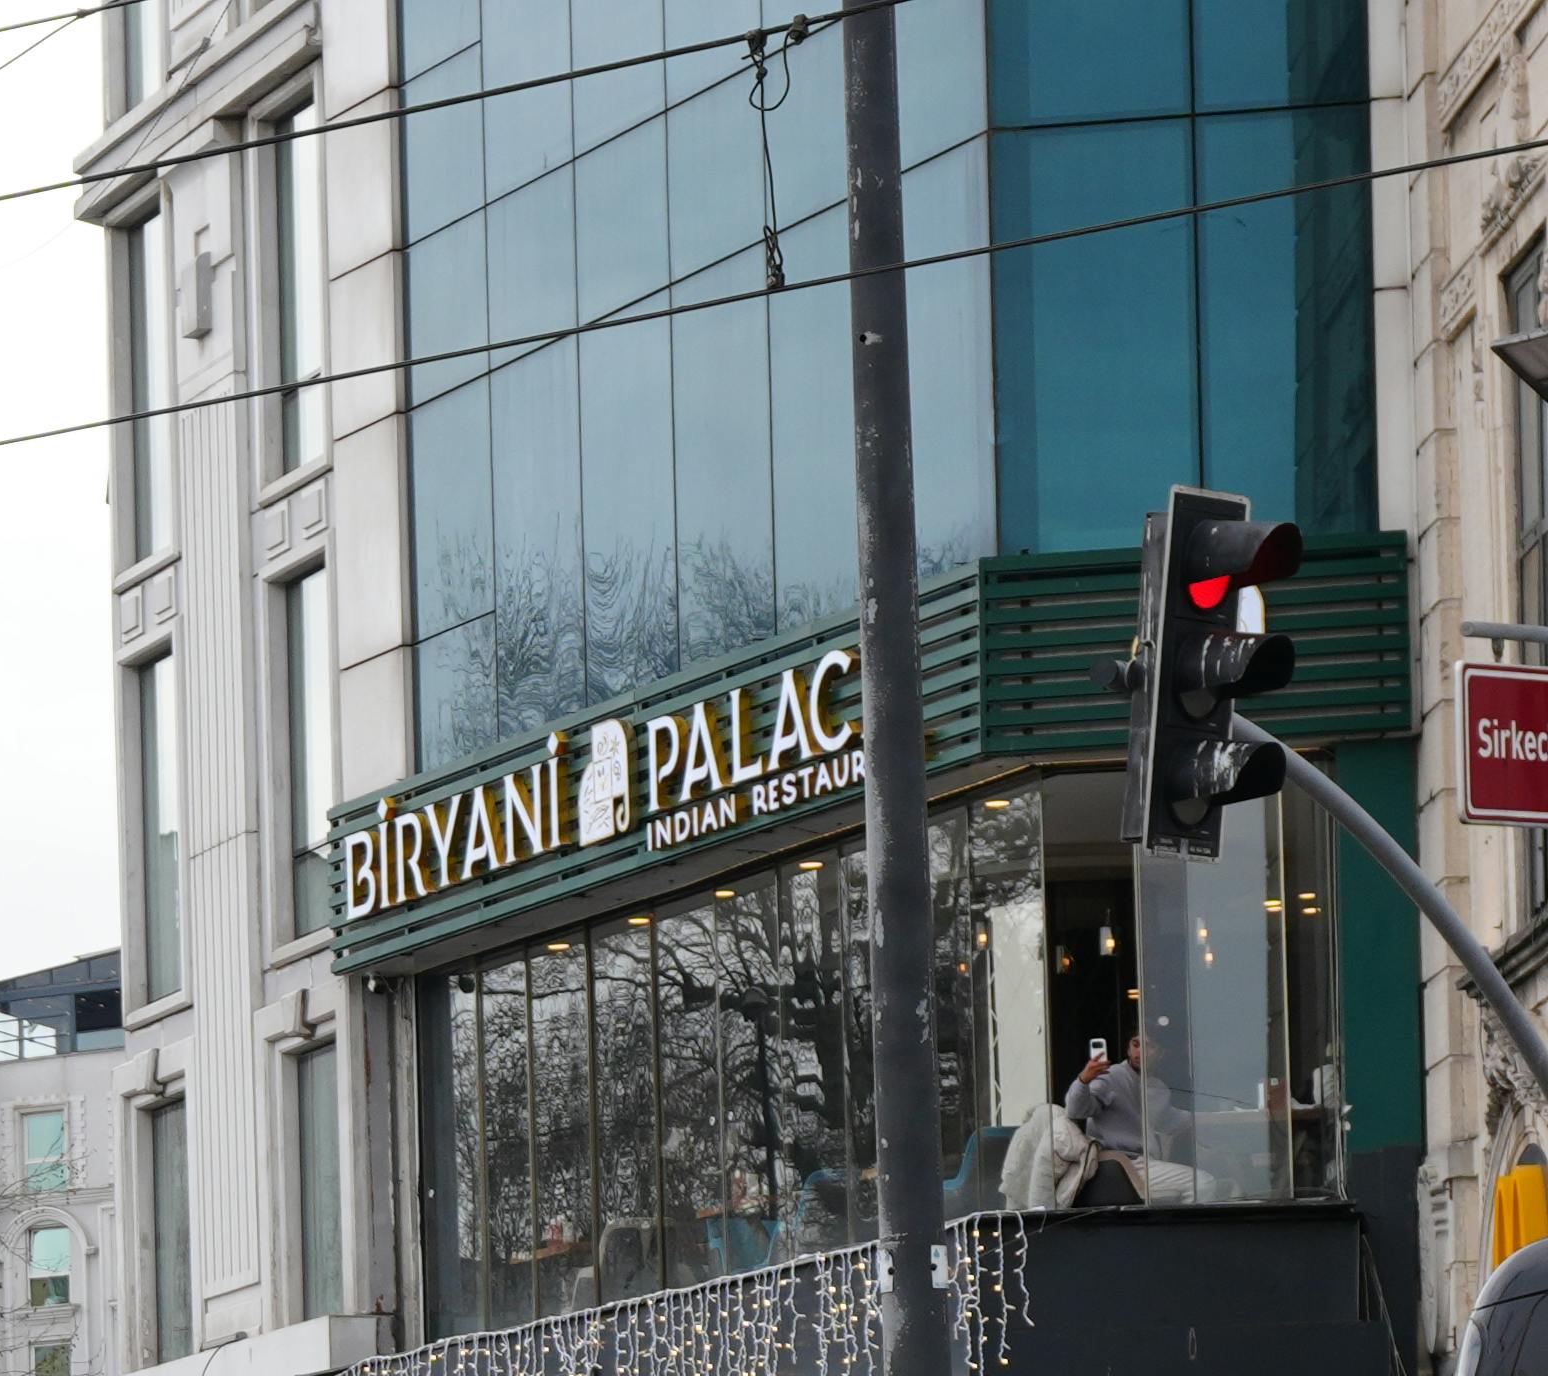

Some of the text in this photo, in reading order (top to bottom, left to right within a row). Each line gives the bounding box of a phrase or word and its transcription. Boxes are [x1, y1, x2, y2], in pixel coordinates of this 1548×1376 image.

[647, 649, 863, 813] PALAC
[1478, 718, 1548, 761] Sirkec
[646, 750, 866, 851] INDIAN RESTAUR
